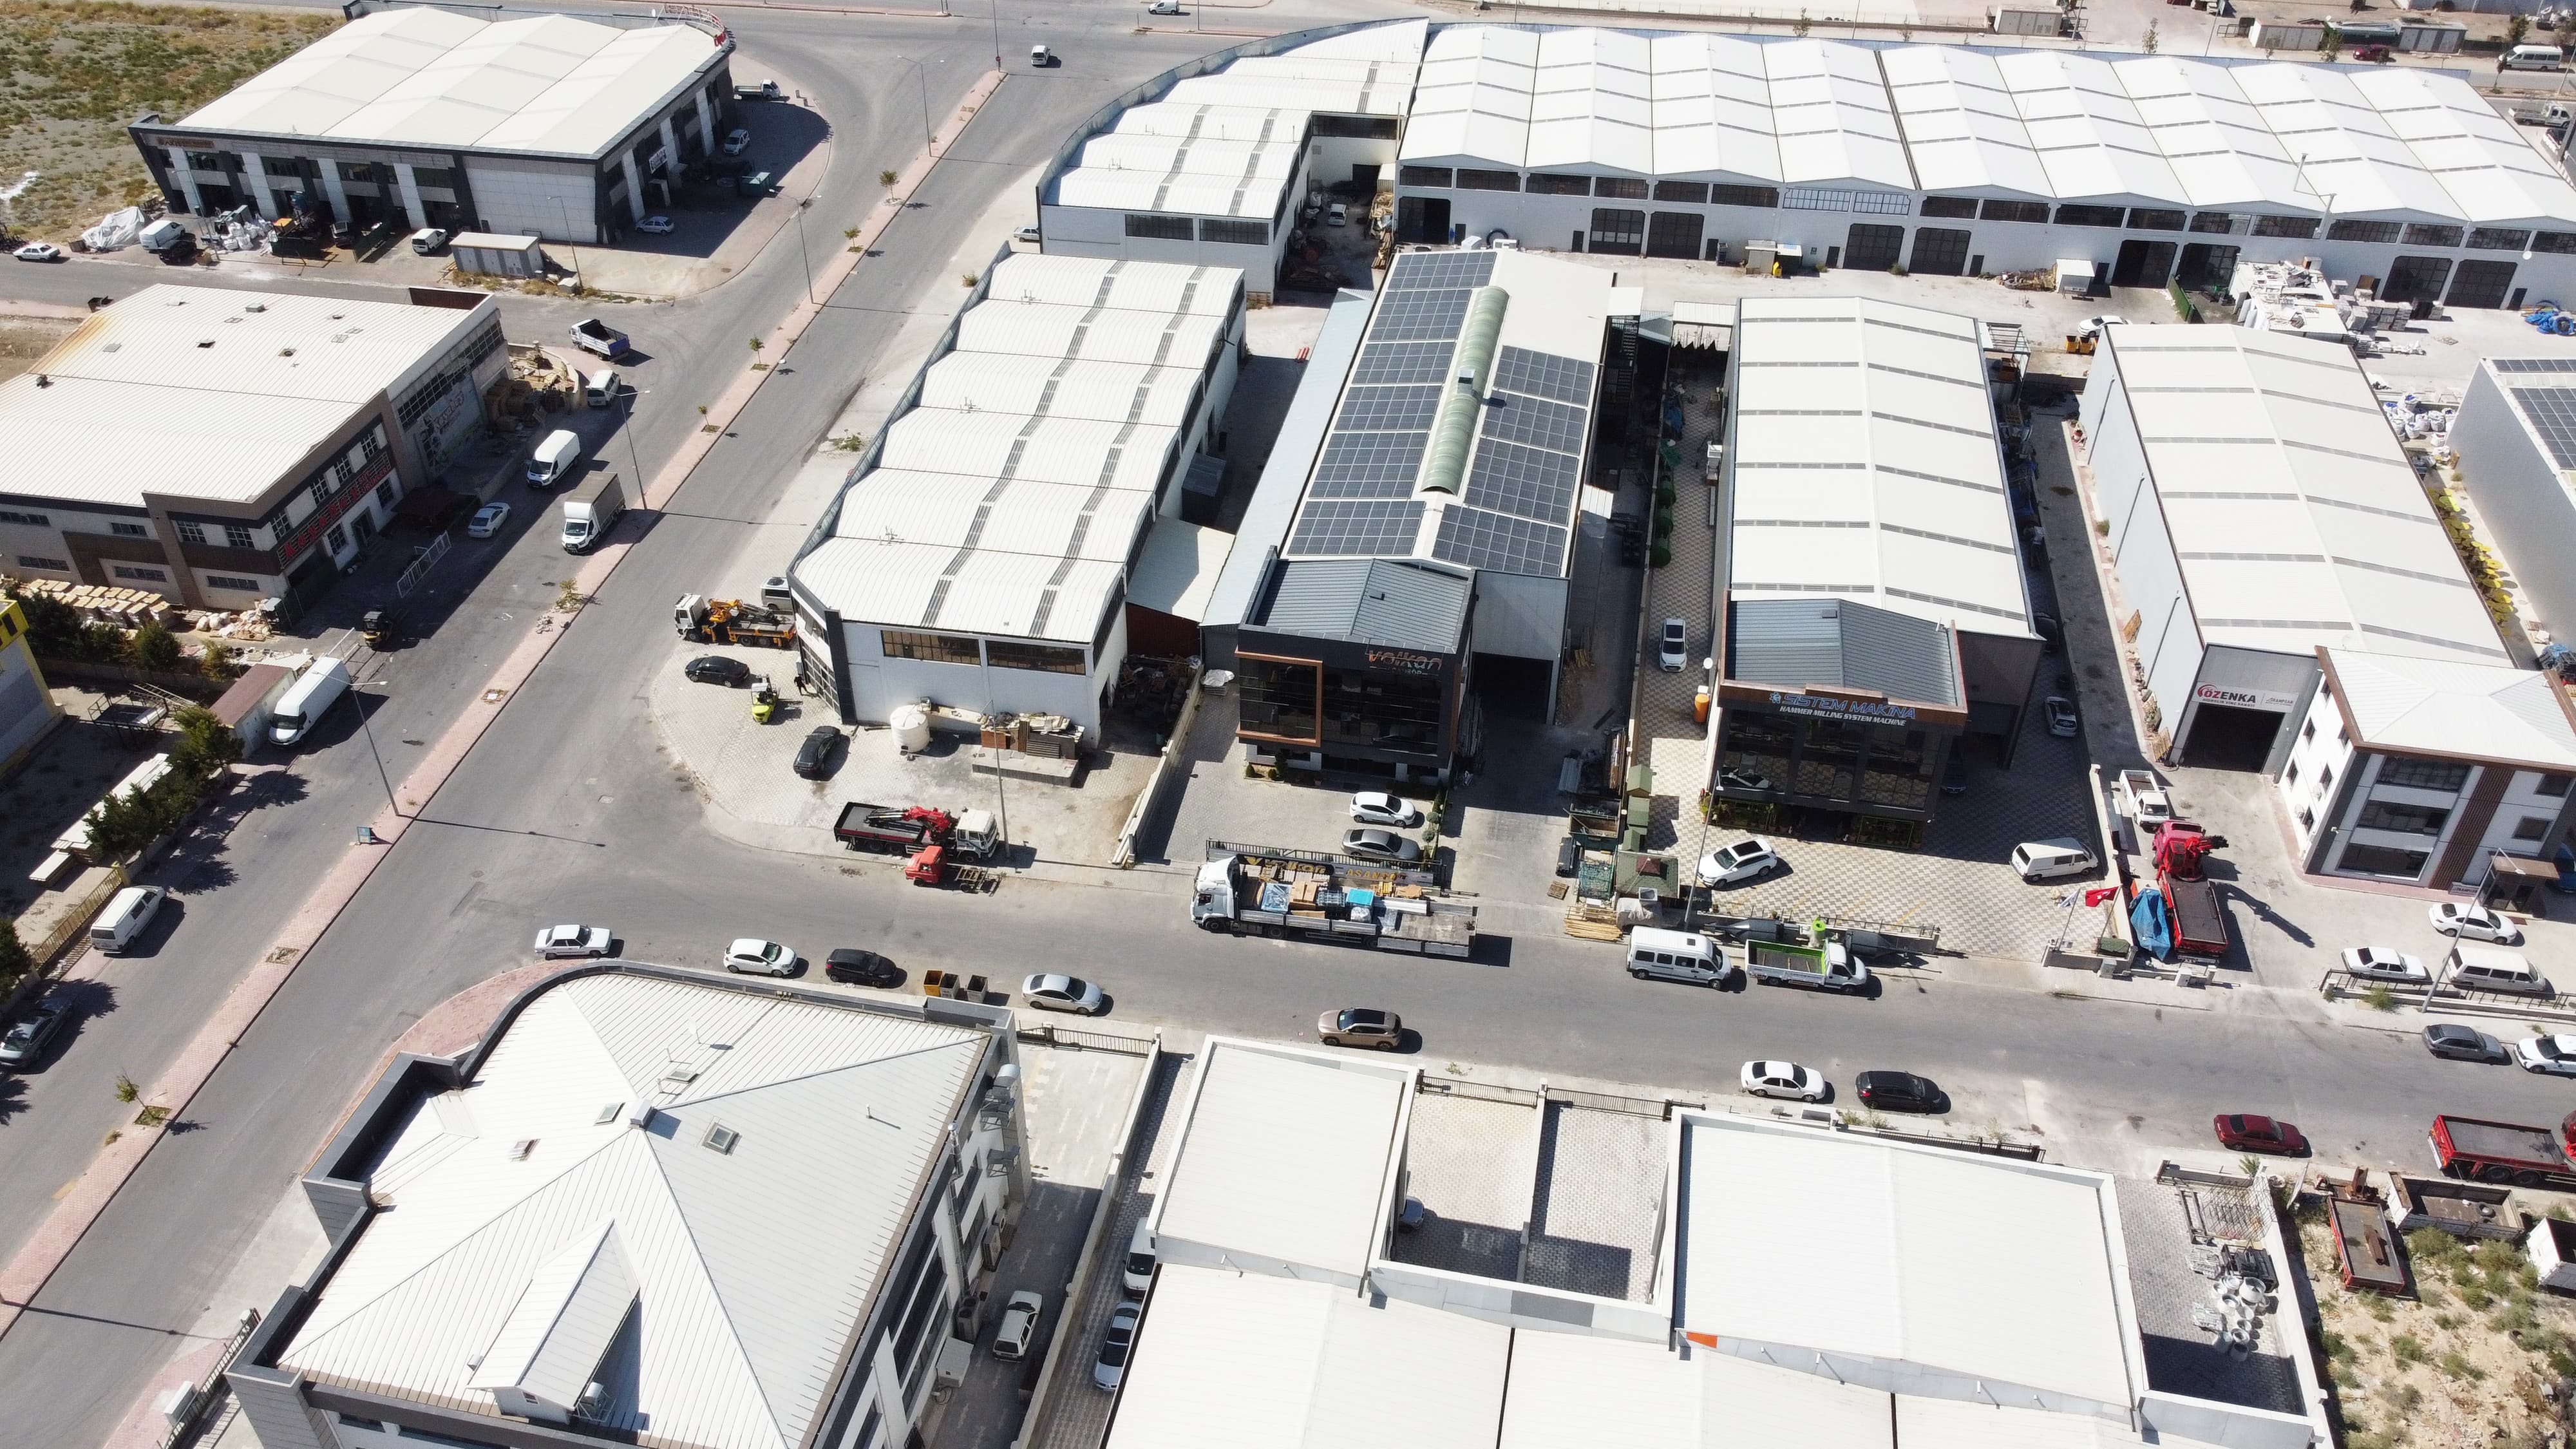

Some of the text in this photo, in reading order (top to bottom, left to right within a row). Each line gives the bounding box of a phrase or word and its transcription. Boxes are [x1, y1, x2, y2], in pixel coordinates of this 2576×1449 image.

[2204, 688, 2256, 703] ÖZENKA
[1779, 706, 1907, 726] HAMMER MILLING SYSTEM MACHINE
